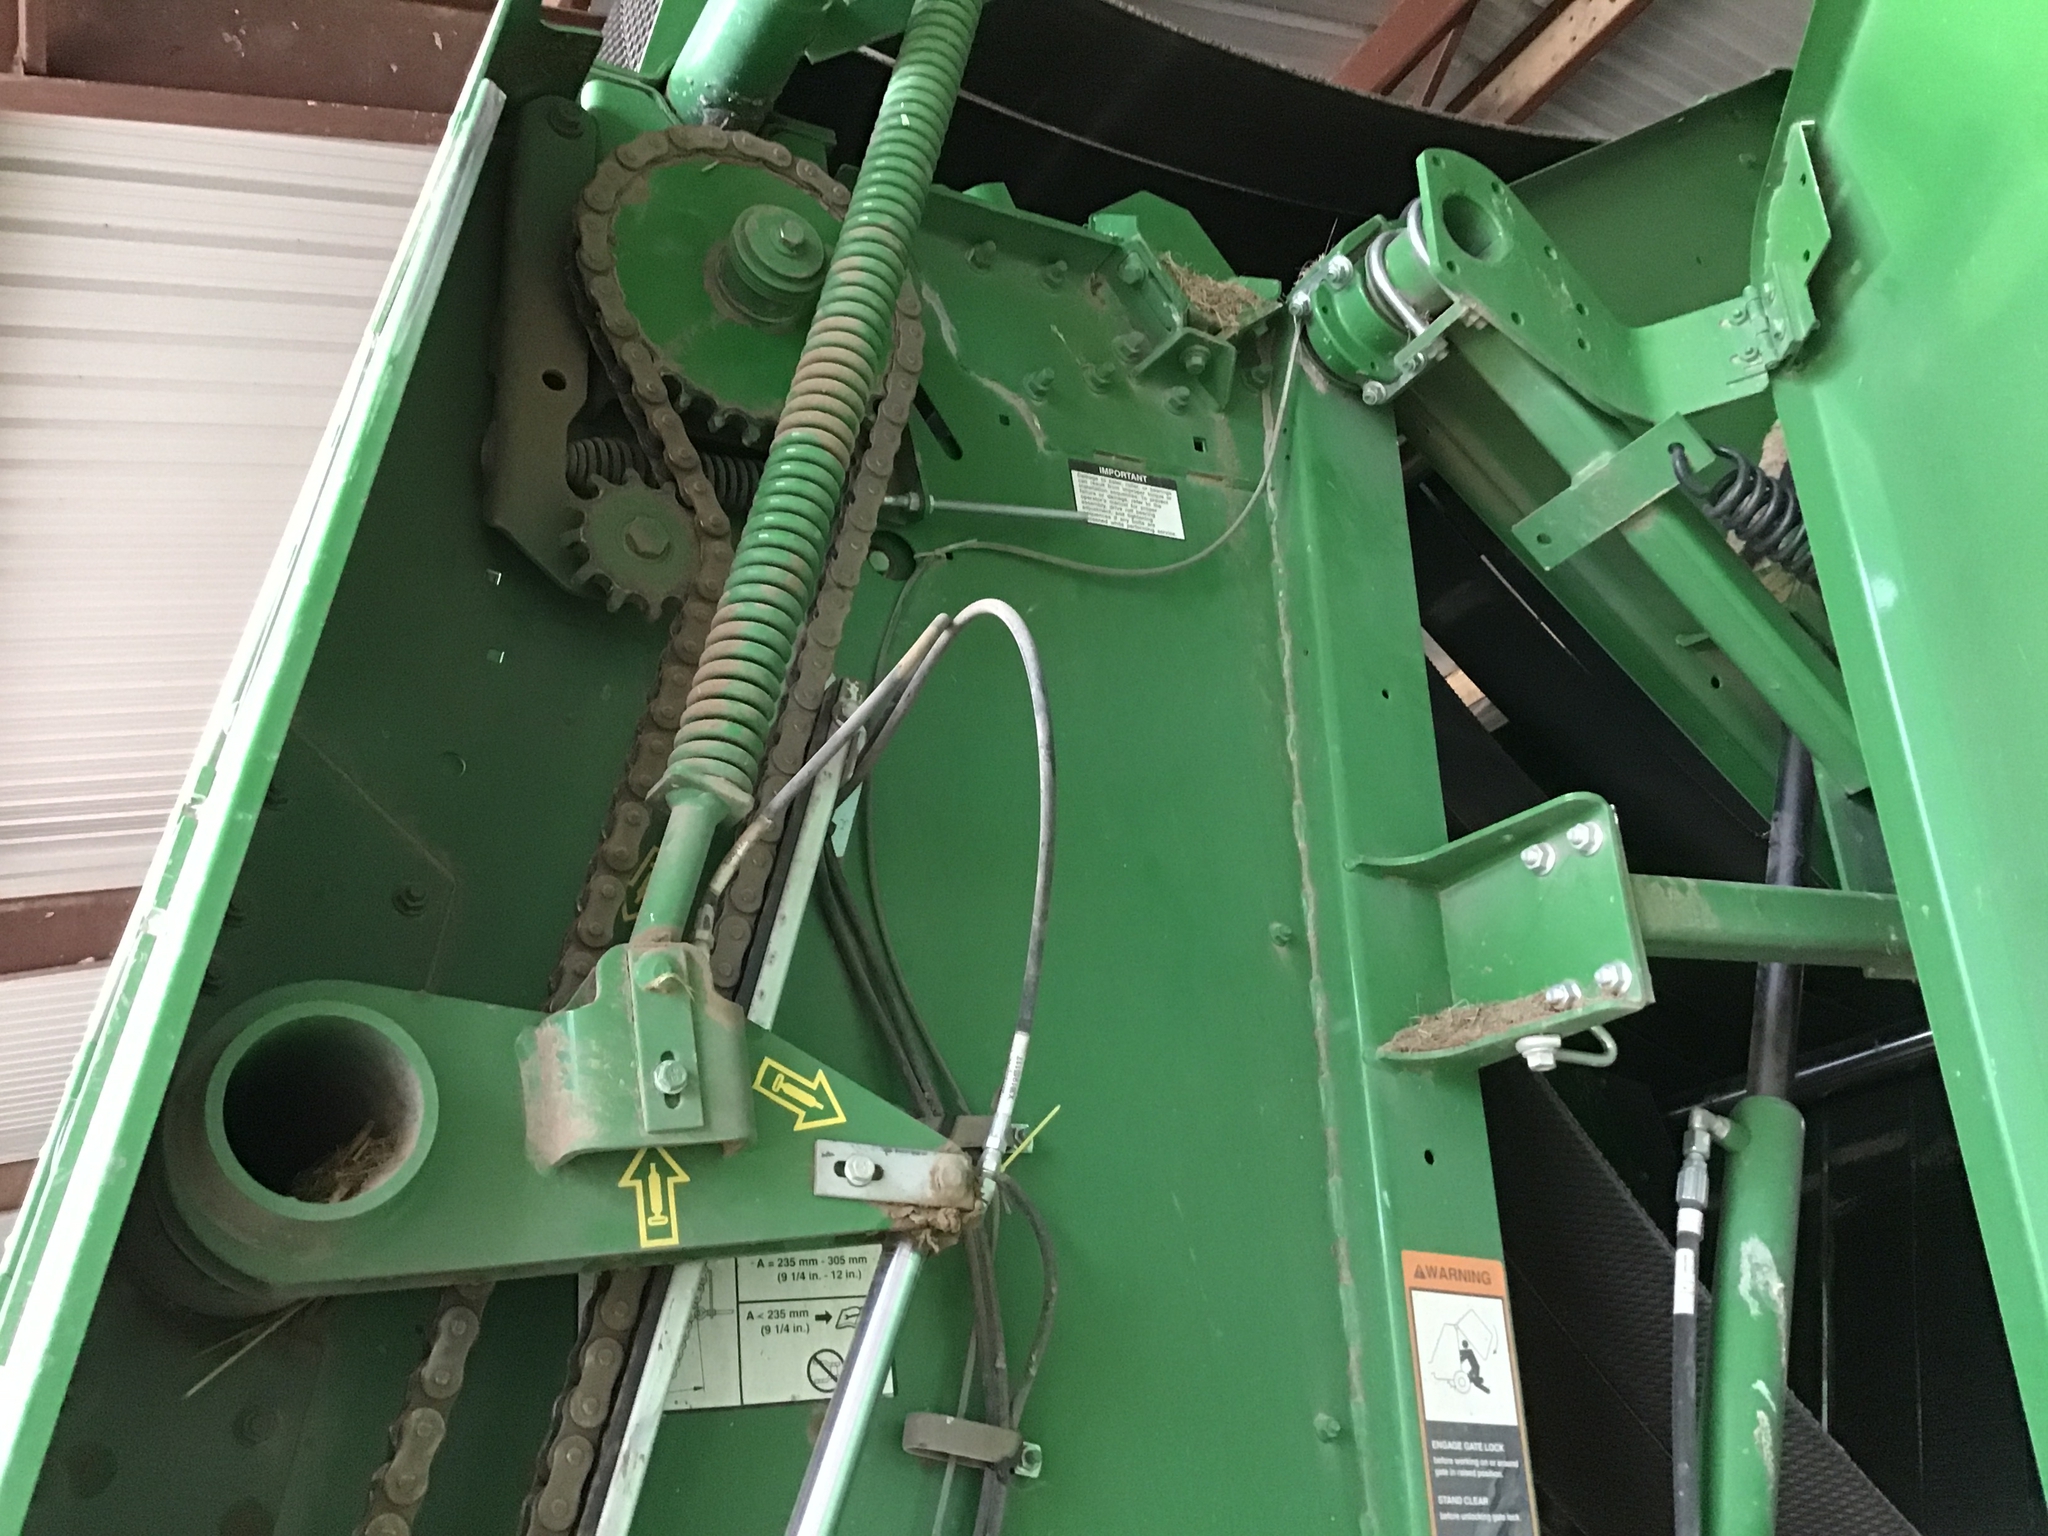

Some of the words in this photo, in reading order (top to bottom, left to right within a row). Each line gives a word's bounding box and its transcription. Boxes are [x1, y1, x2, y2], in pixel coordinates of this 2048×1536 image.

[1099, 466, 1147, 483] IMPORTANT
[757, 1258, 765, 1268] A
[777, 1258, 796, 1268] 235
[799, 1258, 818, 1266] mm
[828, 1256, 846, 1265] 305
[848, 1256, 868, 1264] mm
[777, 1272, 788, 1284] (9
[791, 1271, 806, 1281] 1/4
[808, 1271, 821, 1280] in.
[831, 1270, 843, 1280] 12
[845, 1269, 862, 1280] in.)
[1425, 1265, 1492, 1285] WARNING
[746, 1311, 755, 1321] A
[767, 1309, 786, 1319] 235
[789, 1310, 809, 1318] mm
[760, 1325, 771, 1337] (9
[775, 1324, 789, 1334] 1/4
[793, 1323, 810, 1334] in.)
[1431, 1440, 1462, 1450] ENGAGE
[1463, 1441, 1483, 1451] GATE
[1484, 1443, 1505, 1452] LOCK
[1438, 1495, 1462, 1505] STAND
[1464, 1496, 1488, 1505] CLEAR
